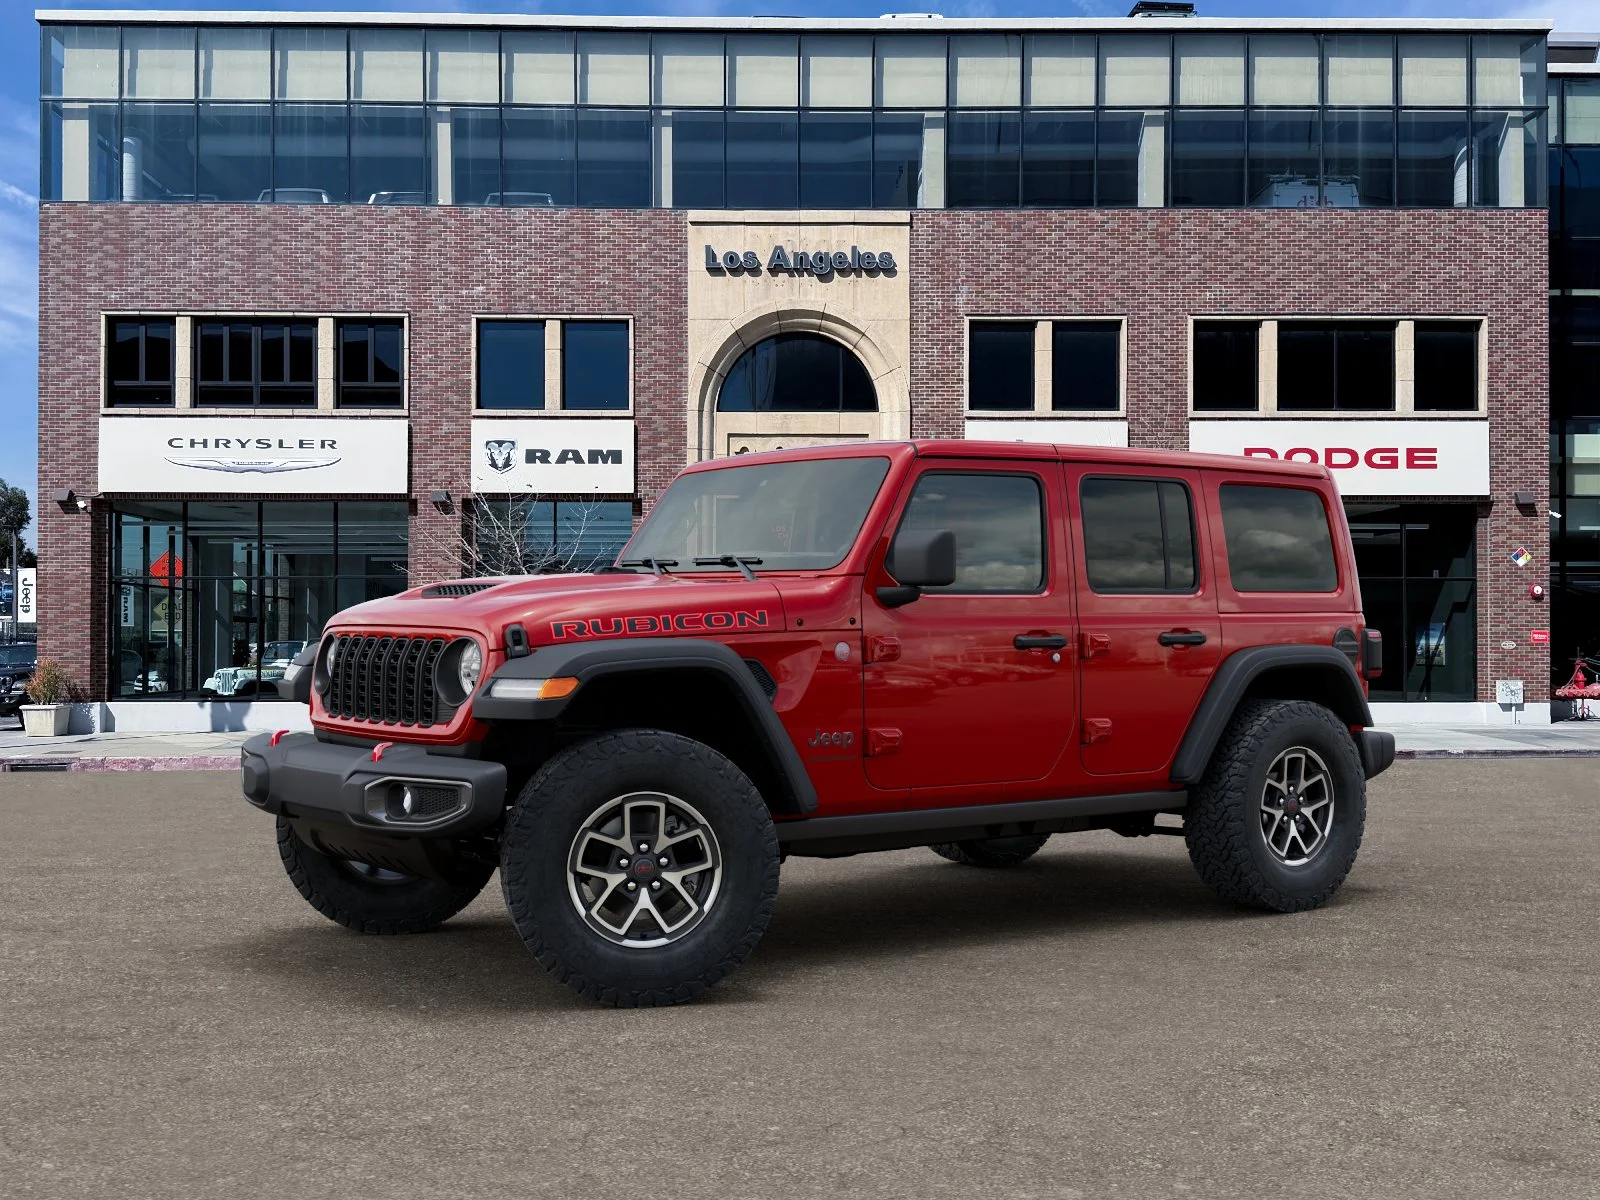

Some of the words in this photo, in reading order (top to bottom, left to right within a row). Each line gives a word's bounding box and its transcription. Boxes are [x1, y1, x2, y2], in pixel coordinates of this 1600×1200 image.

[705, 244, 758, 270] Los
[767, 245, 895, 275] Angeles
[167, 437, 338, 449] CHRYSLER
[525, 448, 623, 465] RAM
[20, 577, 34, 613] Jeep
[164, 612, 181, 620] ED
[550, 609, 769, 639] RUBICON
[808, 728, 855, 749] Jeep
